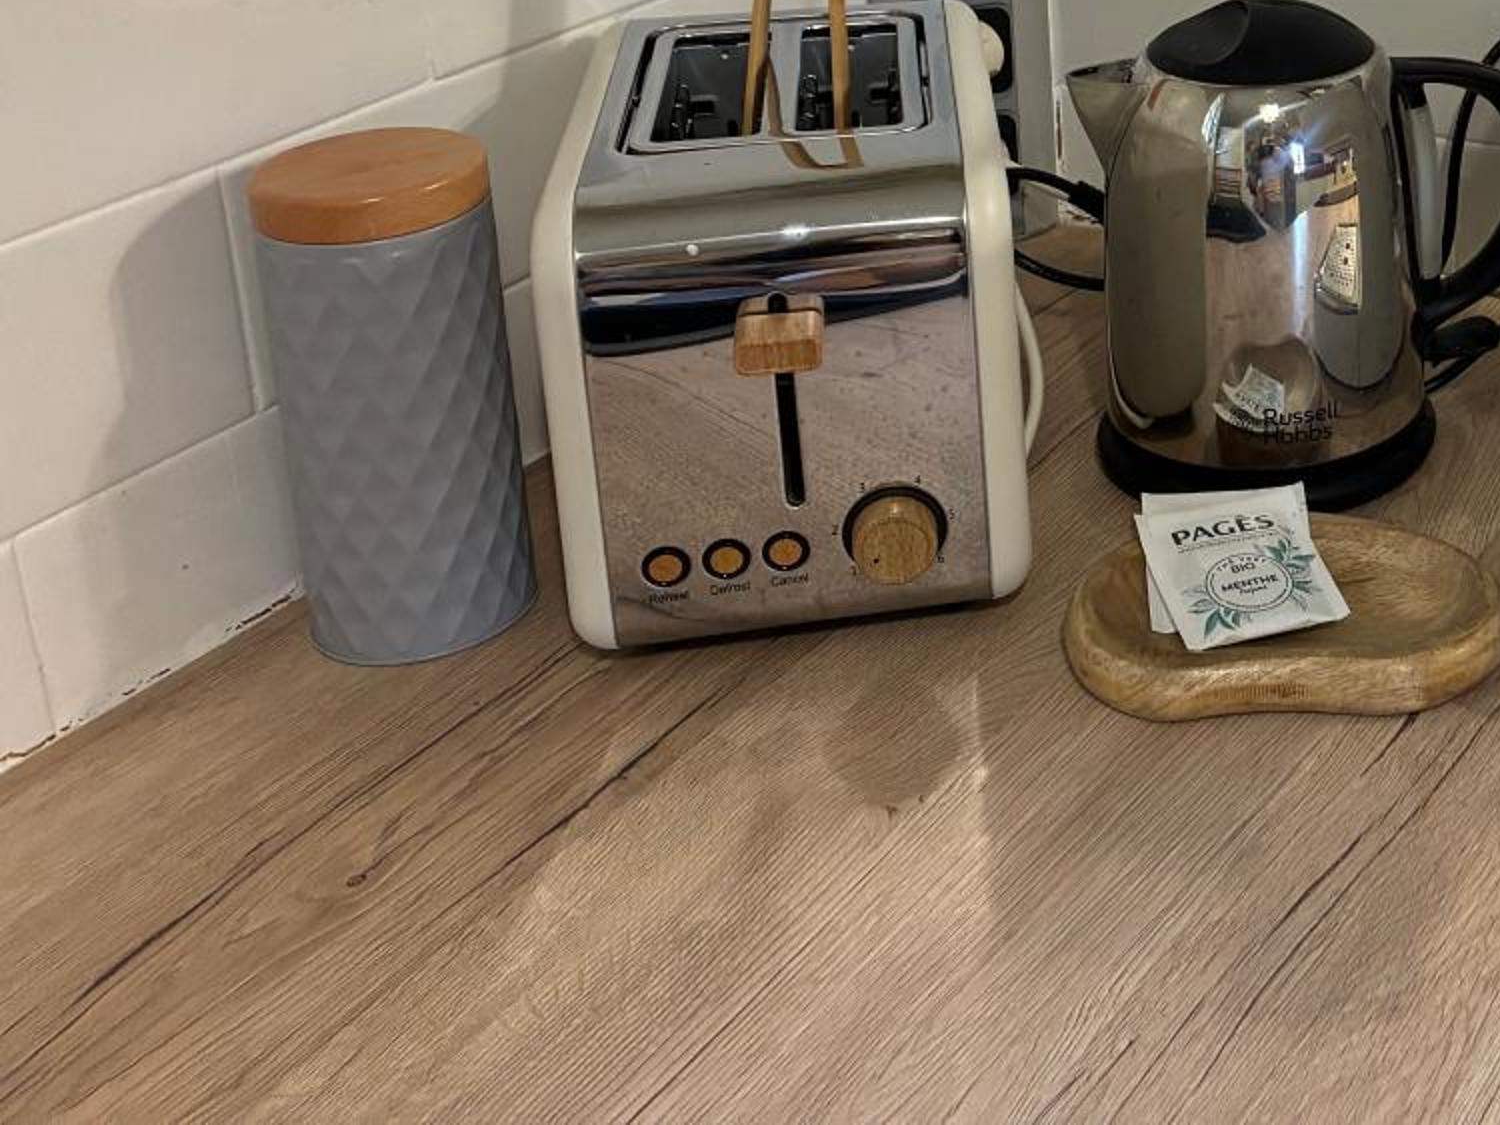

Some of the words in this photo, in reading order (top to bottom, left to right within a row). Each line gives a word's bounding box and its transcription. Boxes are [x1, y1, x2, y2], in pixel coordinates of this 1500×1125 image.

[1263, 399, 1338, 426] Russell
[1264, 424, 1333, 444] Hobbs
[1231, 562, 1256, 573] BIO
[1221, 574, 1279, 592] MENTHE
